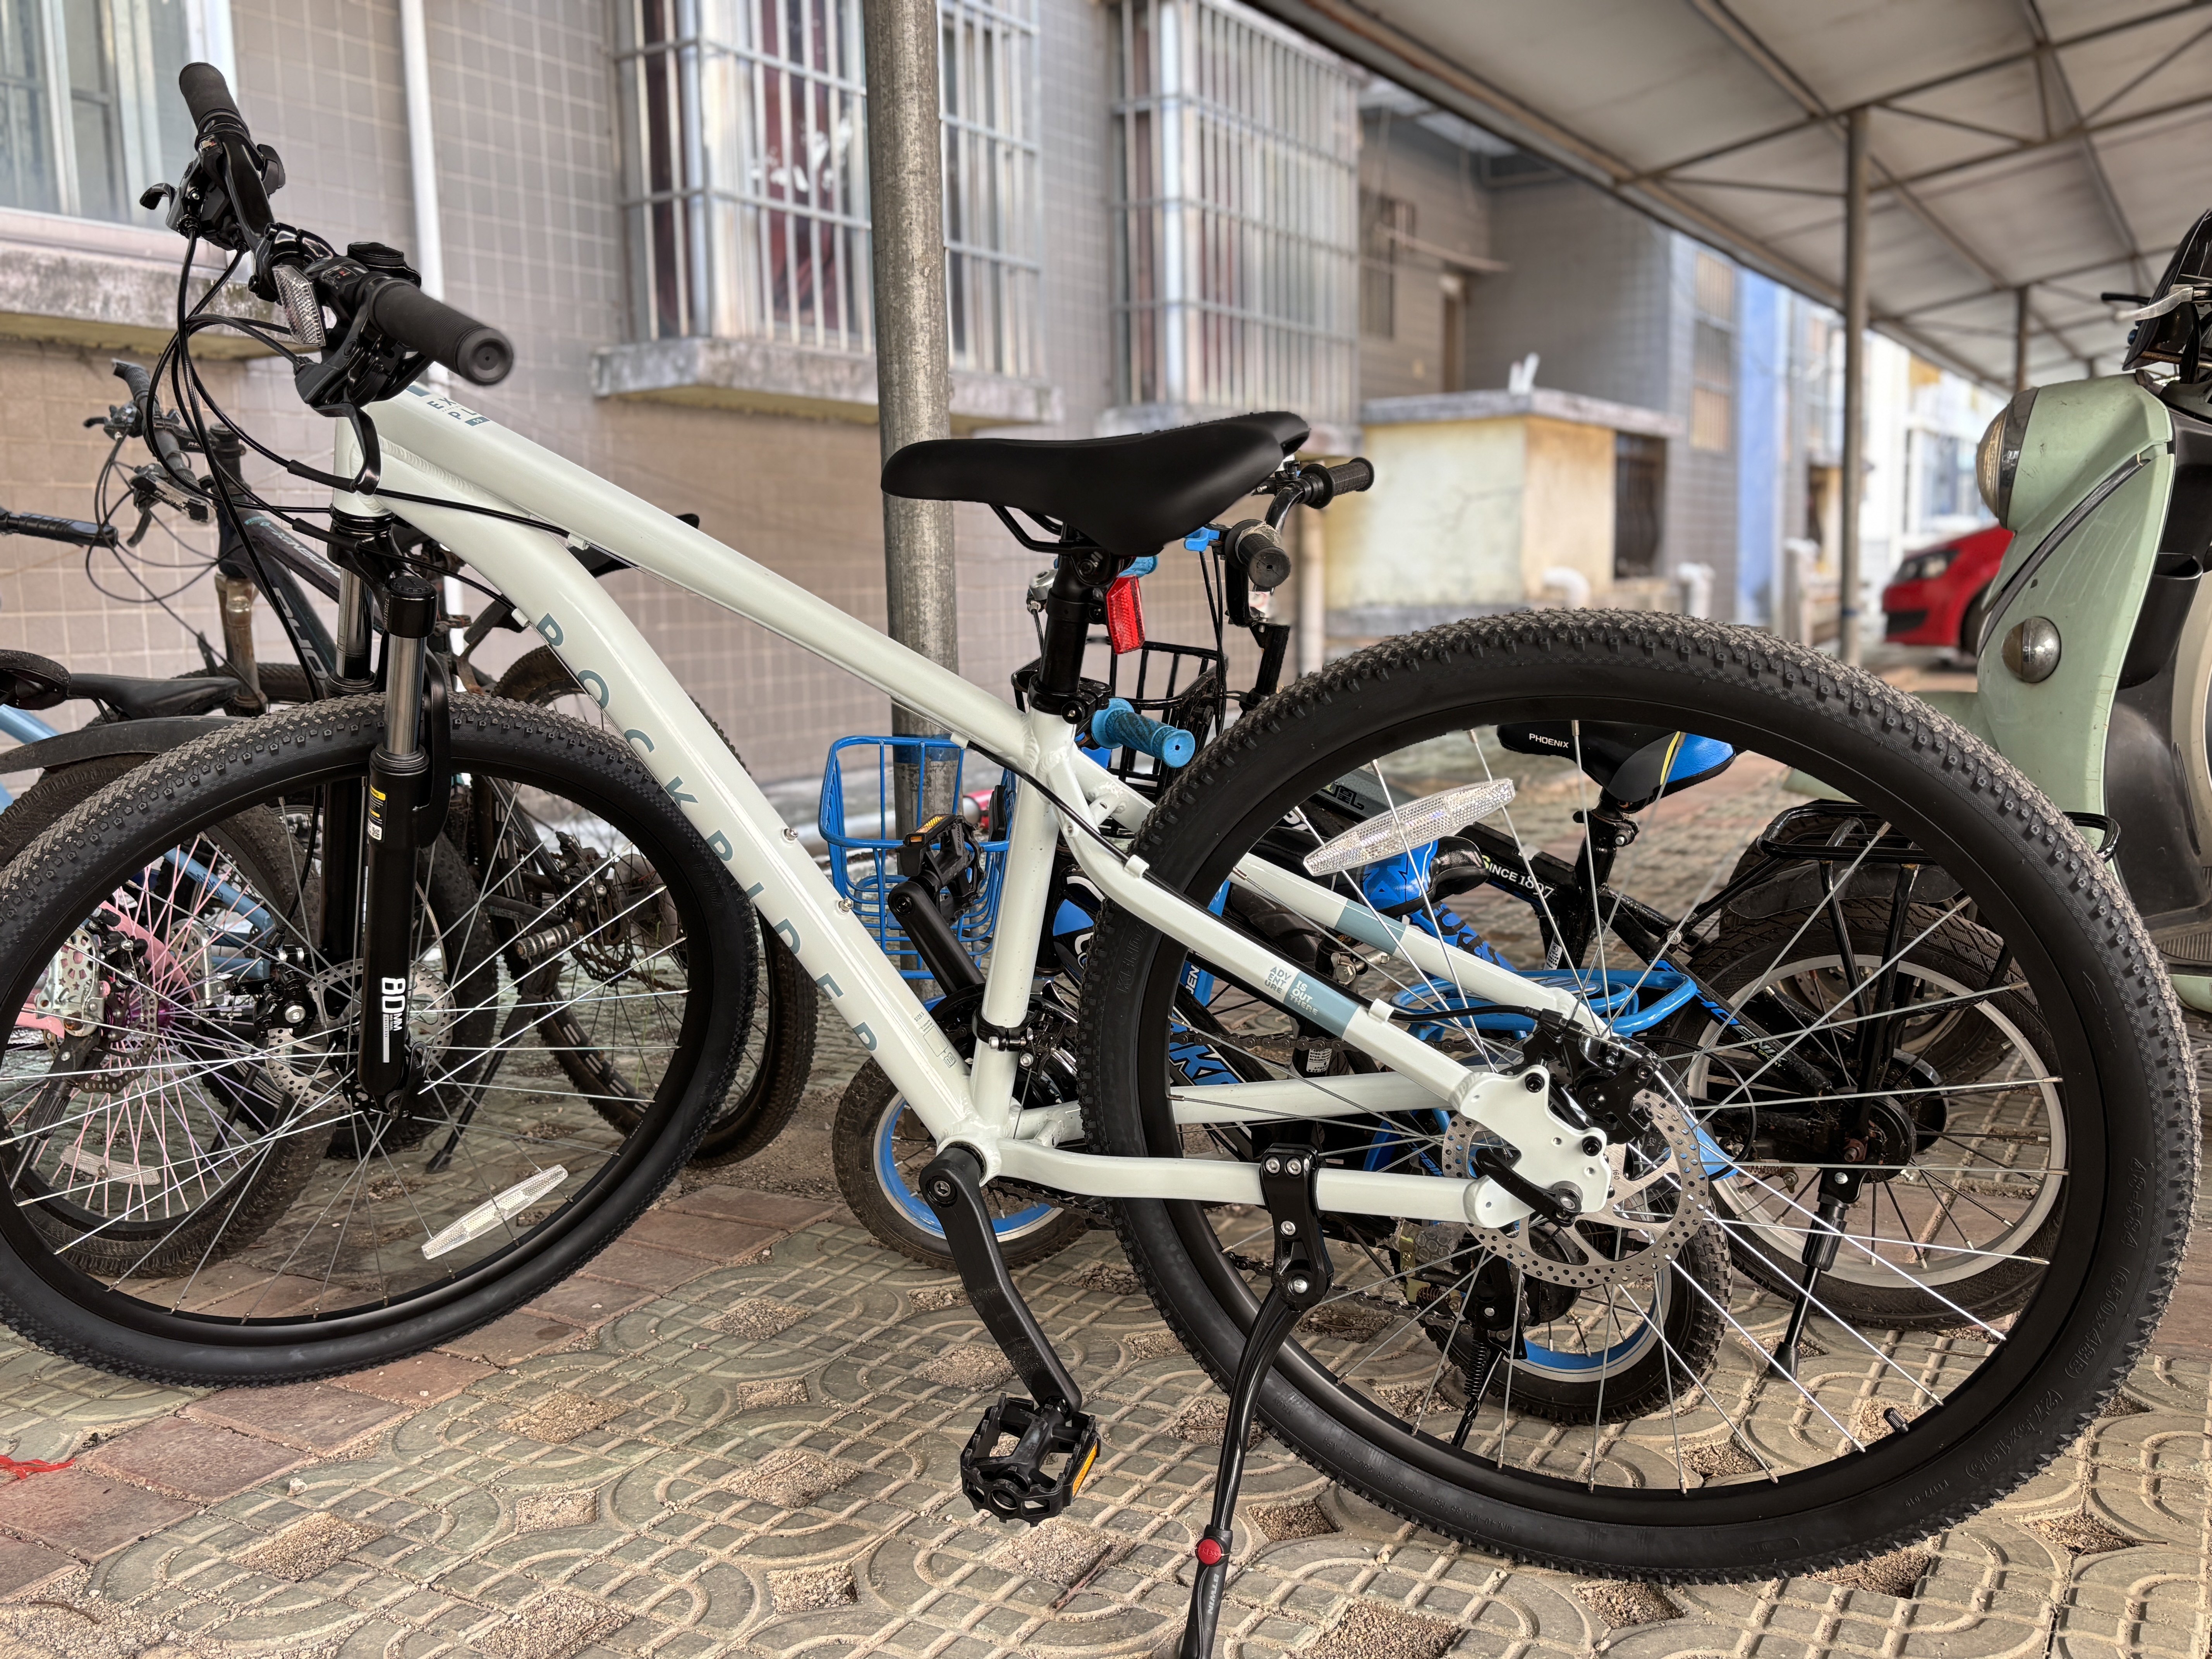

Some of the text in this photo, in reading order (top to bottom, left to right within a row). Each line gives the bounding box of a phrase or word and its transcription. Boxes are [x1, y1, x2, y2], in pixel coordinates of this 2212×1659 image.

[1529, 733, 1570, 748] PHOENIX
[1482, 854, 1518, 883] SINCE
[1115, 922, 1147, 993] KENDA
[1267, 973, 1286, 987] ENT
[1270, 966, 1292, 981] ADV
[1264, 979, 1283, 994] URE
[1295, 980, 1308, 992] IS
[1292, 988, 1313, 1003] OUT
[1290, 994, 1319, 1016] THERE
[2120, 1157, 2148, 1249] 48-584
[1201, 1547, 1219, 1558] PRESS
